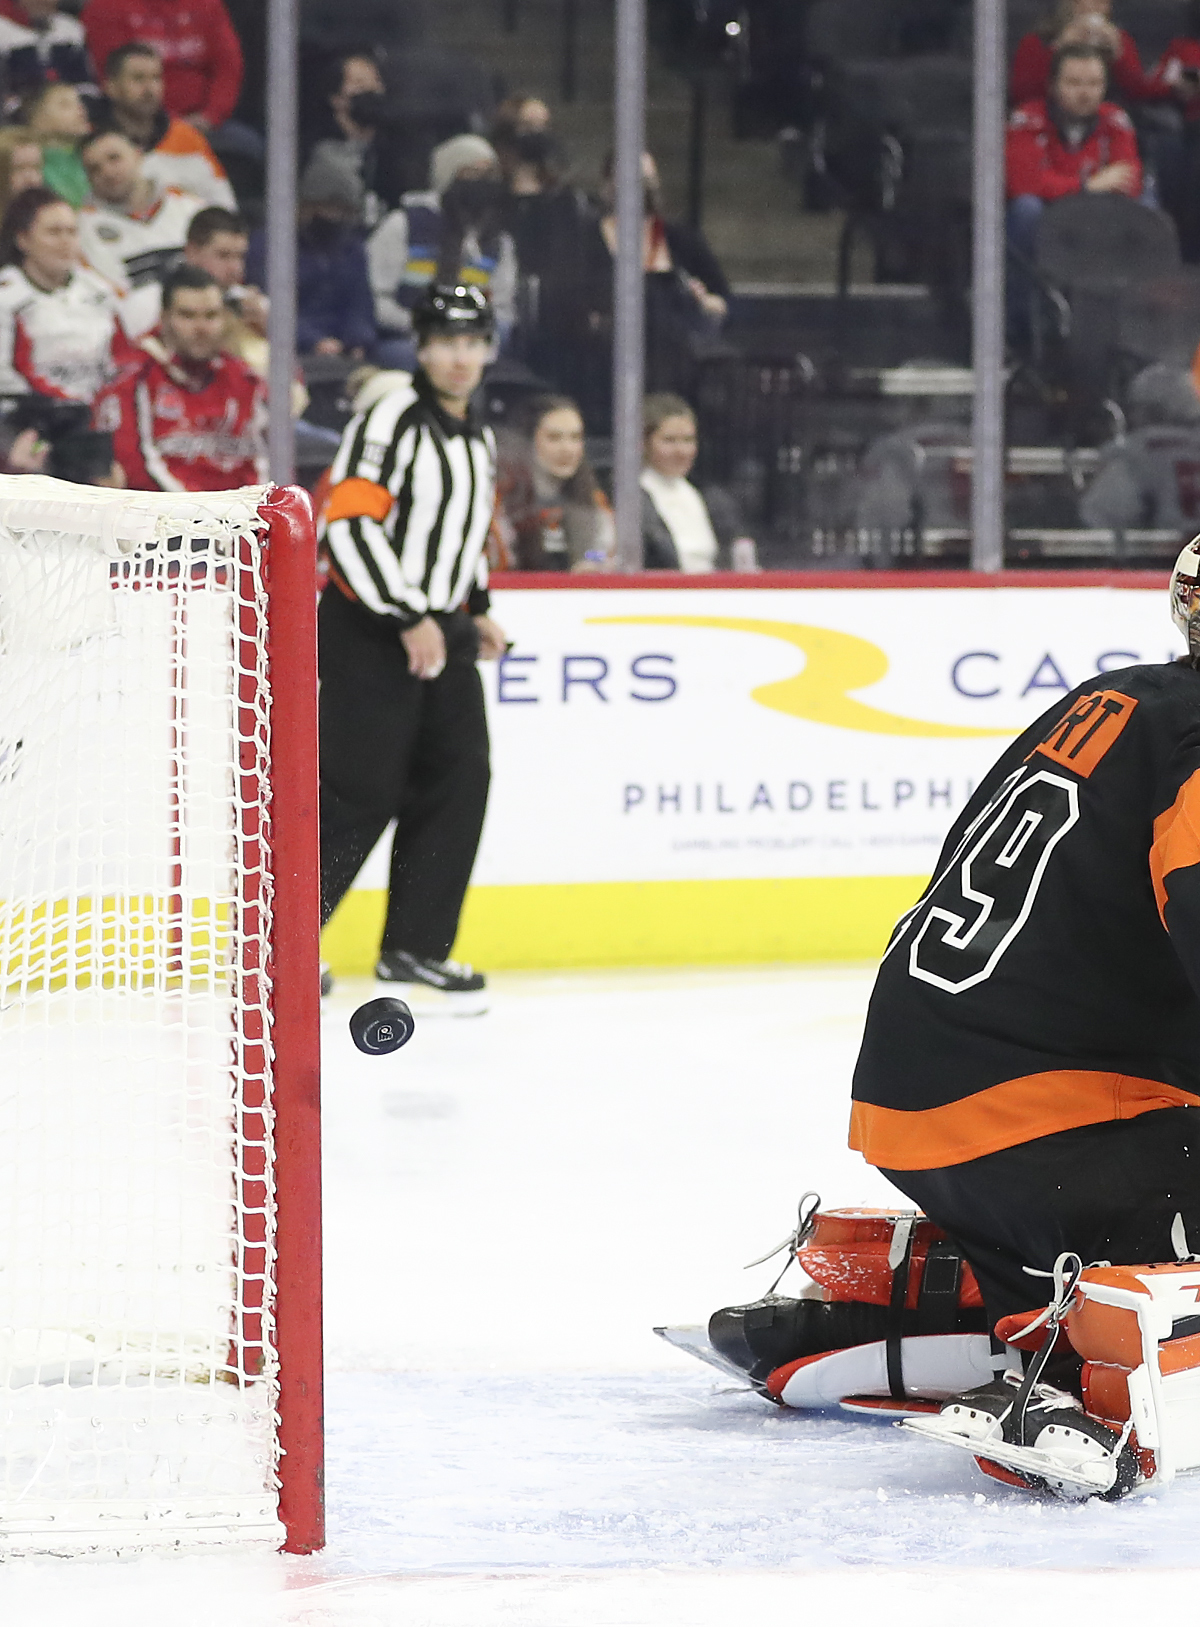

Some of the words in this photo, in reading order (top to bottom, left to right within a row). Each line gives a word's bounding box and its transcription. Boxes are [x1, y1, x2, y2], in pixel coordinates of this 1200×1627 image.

[498, 655, 677, 702] ERS
[623, 780, 974, 814] PHILADELPHI
[882, 765, 1080, 995] 9
